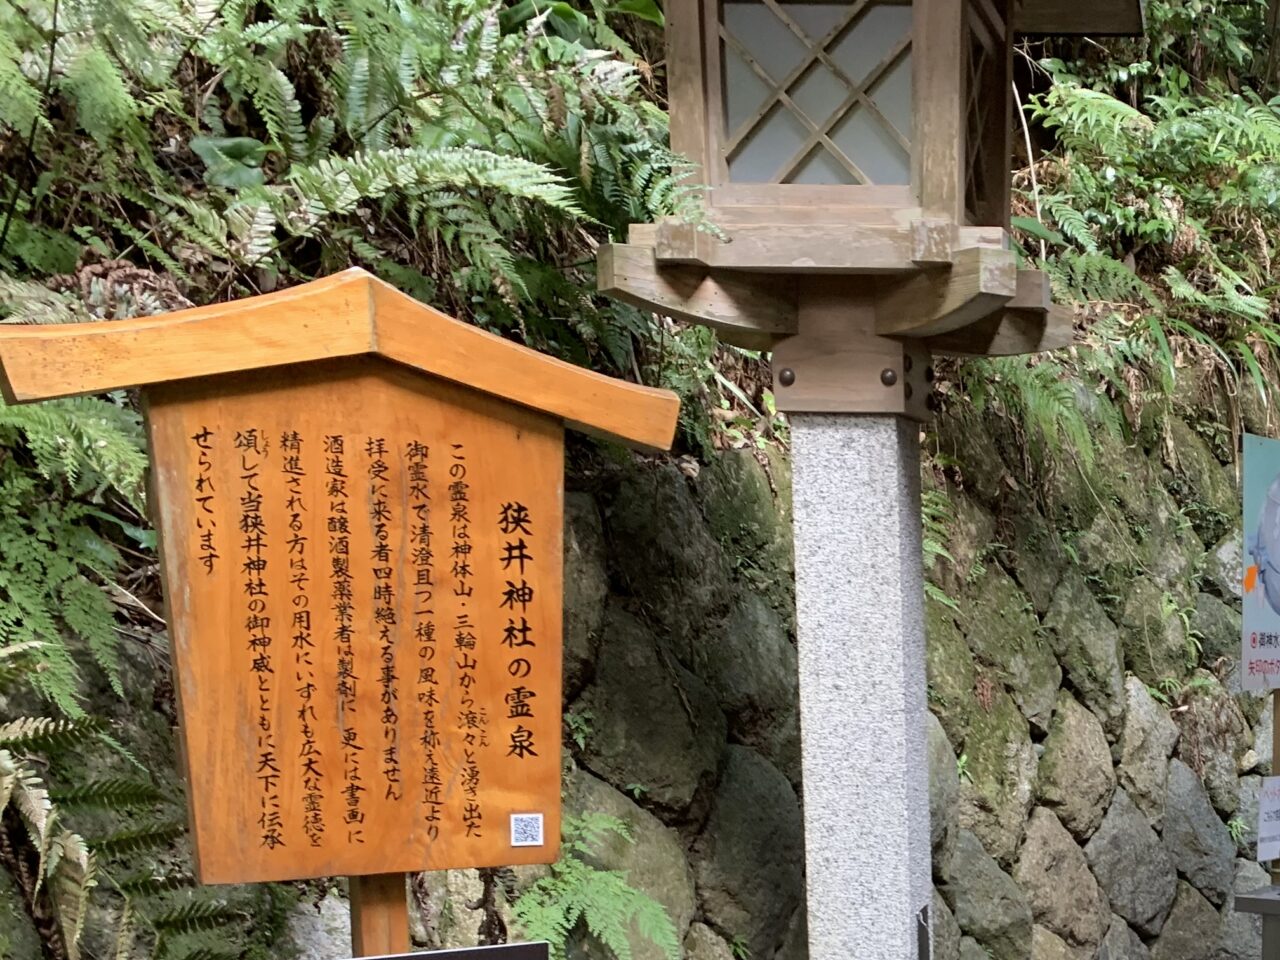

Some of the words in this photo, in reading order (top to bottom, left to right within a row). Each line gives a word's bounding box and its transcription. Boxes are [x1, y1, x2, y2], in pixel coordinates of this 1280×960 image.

[190, 424, 219, 576] せられています
[497, 501, 538, 760] 狭井神社の霊泉
